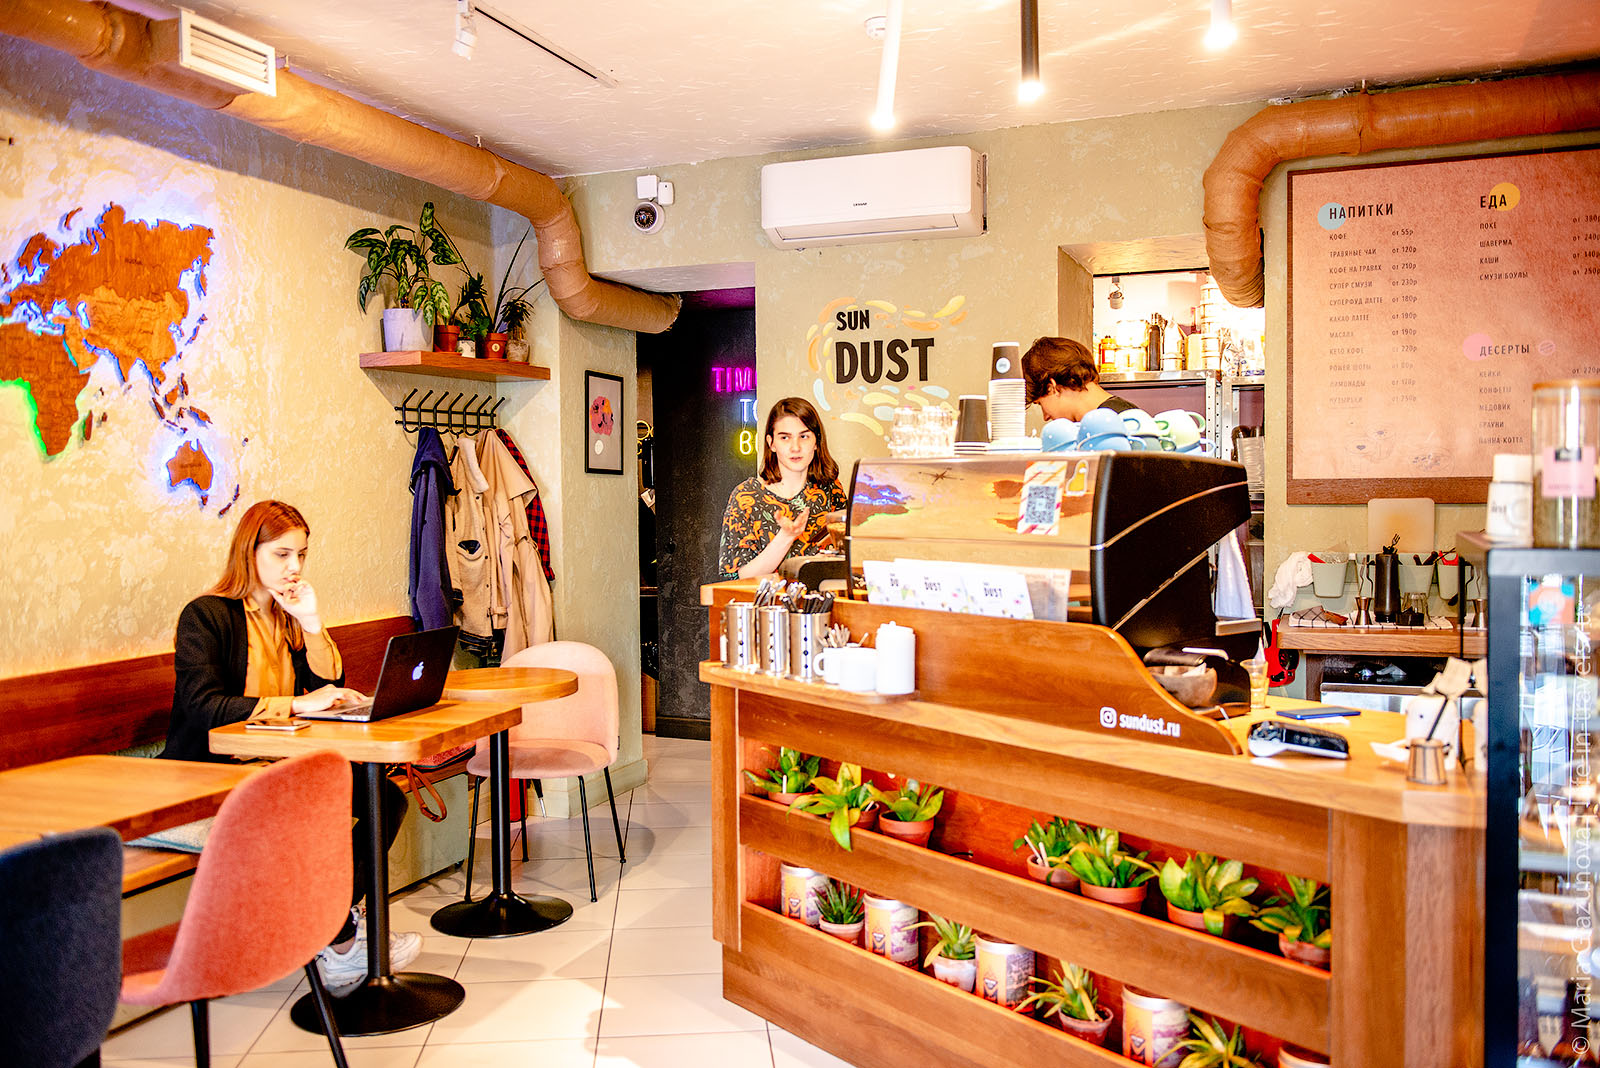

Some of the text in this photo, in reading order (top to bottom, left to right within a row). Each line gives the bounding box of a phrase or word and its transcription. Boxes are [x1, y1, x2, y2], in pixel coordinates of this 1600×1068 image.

[1480, 194, 1507, 209] ЕДА
[1329, 203, 1394, 220] НАПИТКИ
[1329, 233, 1347, 241] КОФЕ
[1479, 239, 1513, 248] ШАВЕРМА
[1329, 249, 1362, 258] ТРАВЯНЫЕ
[1402, 246, 1417, 254] 120р
[1479, 256, 1499, 265] КАШИ
[1329, 266, 1347, 274] КОФЕ
[1329, 282, 1349, 290] СУПЕР
[836, 310, 870, 331] SUN
[1401, 328, 1417, 337] 190р
[1479, 344, 1530, 357] ДЕСЕРТЫ
[835, 338, 935, 384] DUST
[712, 367, 757, 392] TIM
[1479, 403, 1511, 412] МЕДОВИК
[740, 430, 758, 455] B
[1119, 714, 1181, 738] sundust.ru
